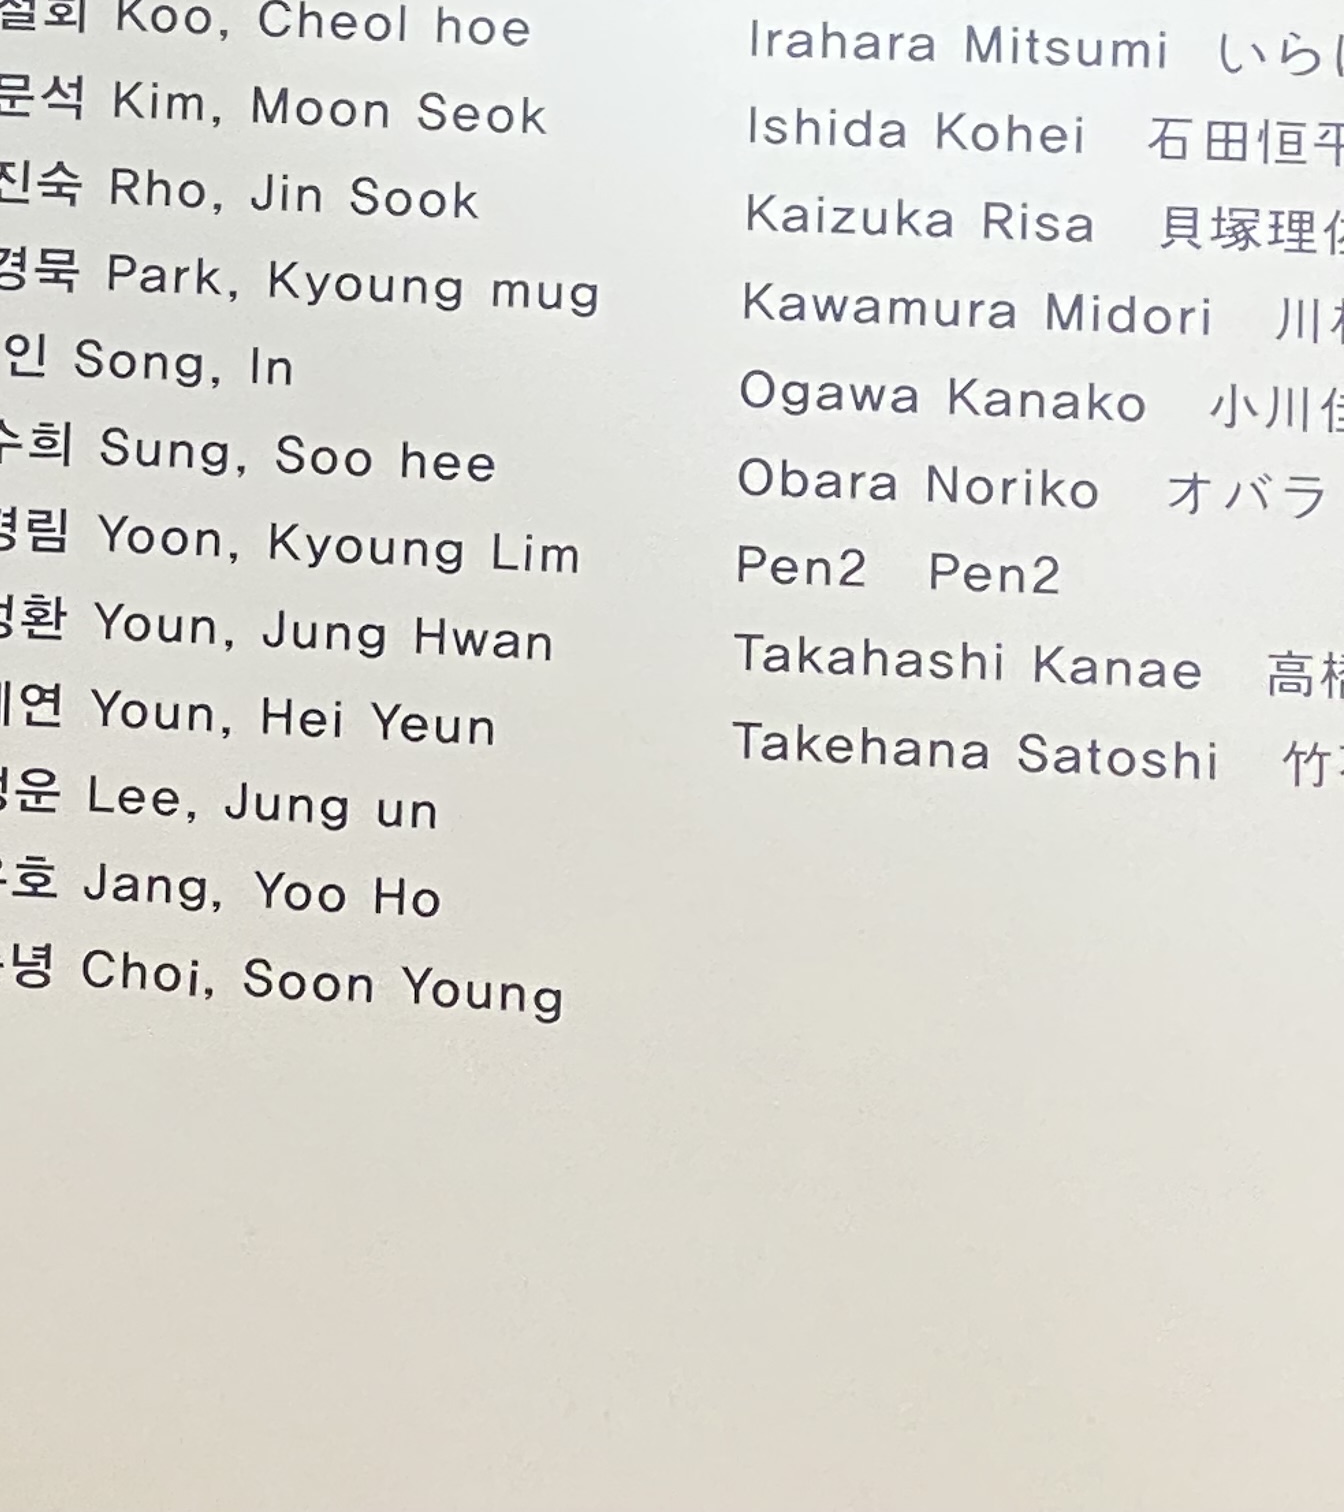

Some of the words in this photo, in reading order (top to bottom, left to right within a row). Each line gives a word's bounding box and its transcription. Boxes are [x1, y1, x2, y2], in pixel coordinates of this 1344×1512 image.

[258, 0, 407, 42] Cheol
[436, 5, 530, 47] hoe
[751, 19, 935, 62] Irahara
[965, 24, 1166, 69] Mitsumi
[1220, 31, 1344, 78] いら
[113, 80, 221, 129] Kim,
[252, 85, 389, 129] Moon
[417, 91, 547, 135] Seok
[749, 105, 906, 149] Ishida
[936, 111, 1083, 154] Kohei
[110, 167, 222, 216] Rho,
[250, 173, 322, 213] Jin
[349, 176, 479, 220] Sook
[747, 193, 953, 239] Kaizuka
[983, 201, 1093, 243] Risa
[107, 253, 238, 303] Park,
[269, 260, 463, 312] Kyoung
[492, 279, 598, 318] mug
[743, 281, 1016, 329] Kawamura
[1046, 292, 1210, 336] Midori
[4, 332, 46, 379] 인
[74, 338, 220, 390] Song,
[251, 346, 292, 386] In
[740, 369, 918, 417] Ogawa
[948, 377, 1146, 423] Kanako
[99, 426, 246, 478] Sung,
[275, 434, 372, 477] Soo
[401, 440, 495, 483] hee
[738, 457, 897, 501] Obara
[927, 464, 1098, 510] Noriko
[1168, 471, 1324, 520] オバラ
[97, 513, 238, 565] Yoon,
[269, 521, 463, 575] Kyoung
[492, 532, 579, 574] Lim
[737, 544, 866, 588] Pen2
[930, 552, 1059, 595] Pen2
[93, 601, 234, 653] Youn,
[262, 609, 386, 660] Jung
[415, 616, 552, 662] Hwan
[733, 633, 1003, 681] Takahashi
[1034, 644, 1202, 690] Kanae
[90, 688, 231, 740] Youn,
[262, 696, 342, 738] Hei
[370, 701, 494, 746] Yeun
[731, 721, 989, 770] Takehana
[1017, 733, 1216, 781] Satoshi
[1282, 740, 1344, 788] 竹
[88, 774, 196, 824] Lee,
[224, 781, 349, 832] Jung
[377, 798, 436, 830] un
[83, 862, 222, 913] Jang,
[254, 870, 346, 913] Yoo
[374, 876, 441, 918] Ho
[82, 949, 214, 1001] Choi,
[243, 957, 373, 1004] Soon
[401, 965, 562, 1025] Young
